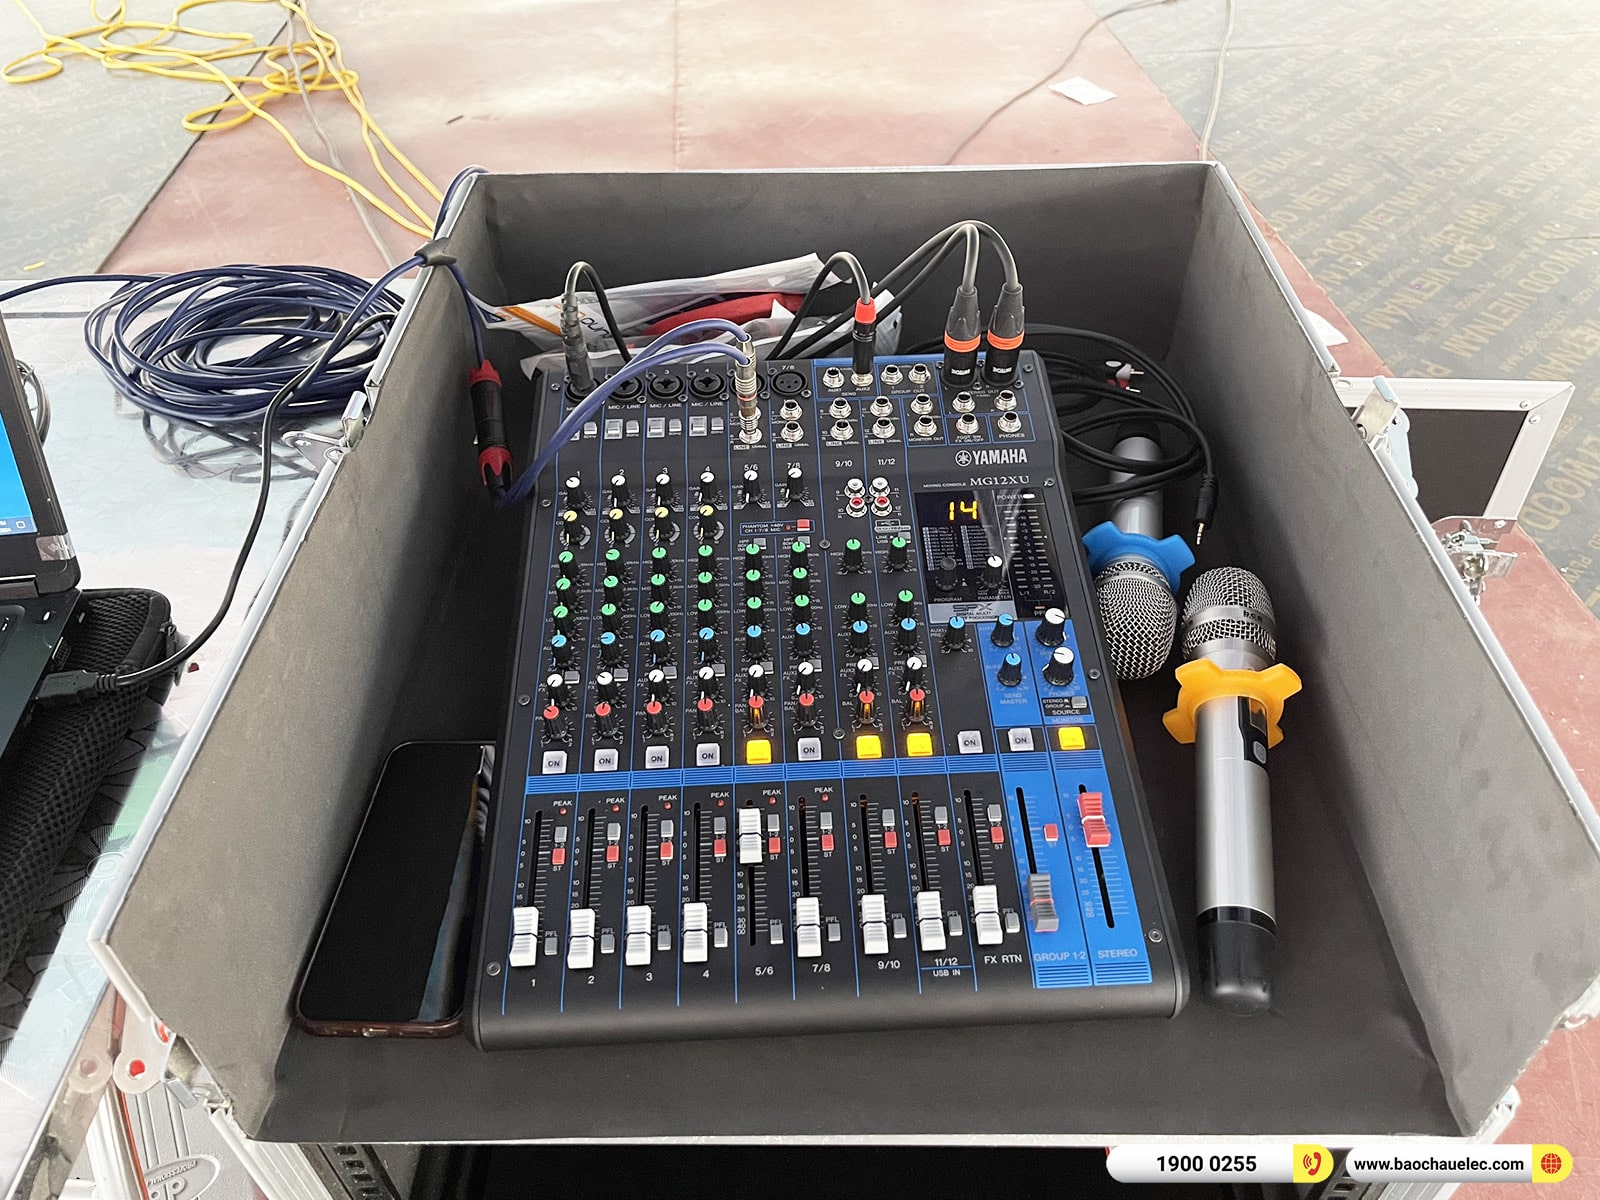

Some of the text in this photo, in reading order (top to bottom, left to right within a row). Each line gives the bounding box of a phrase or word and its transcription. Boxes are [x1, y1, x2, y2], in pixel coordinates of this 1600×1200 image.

[1360, 266, 1460, 331] VIETNAM
[1440, 291, 1538, 360] VIETNAM
[972, 448, 1028, 465] YAMAHA
[835, 460, 853, 468] 9/10
[878, 458, 896, 466] 11/12
[970, 475, 1030, 486] MG12XU
[949, 500, 978, 521] 14
[803, 746, 815, 754] ON
[1034, 951, 1086, 961] GROUP 1-2
[1097, 949, 1138, 958] STEREO
[935, 958, 958, 966] 11/12
[984, 954, 1023, 964] FX RTN
[812, 963, 831, 972] 7/8
[878, 960, 901, 969] 9/10
[703, 970, 710, 978] 4
[755, 967, 774, 976] 5/6
[933, 969, 949, 977] USB
[588, 976, 595, 984] 2
[646, 972, 653, 981] 3
[531, 978, 536, 987] 1
